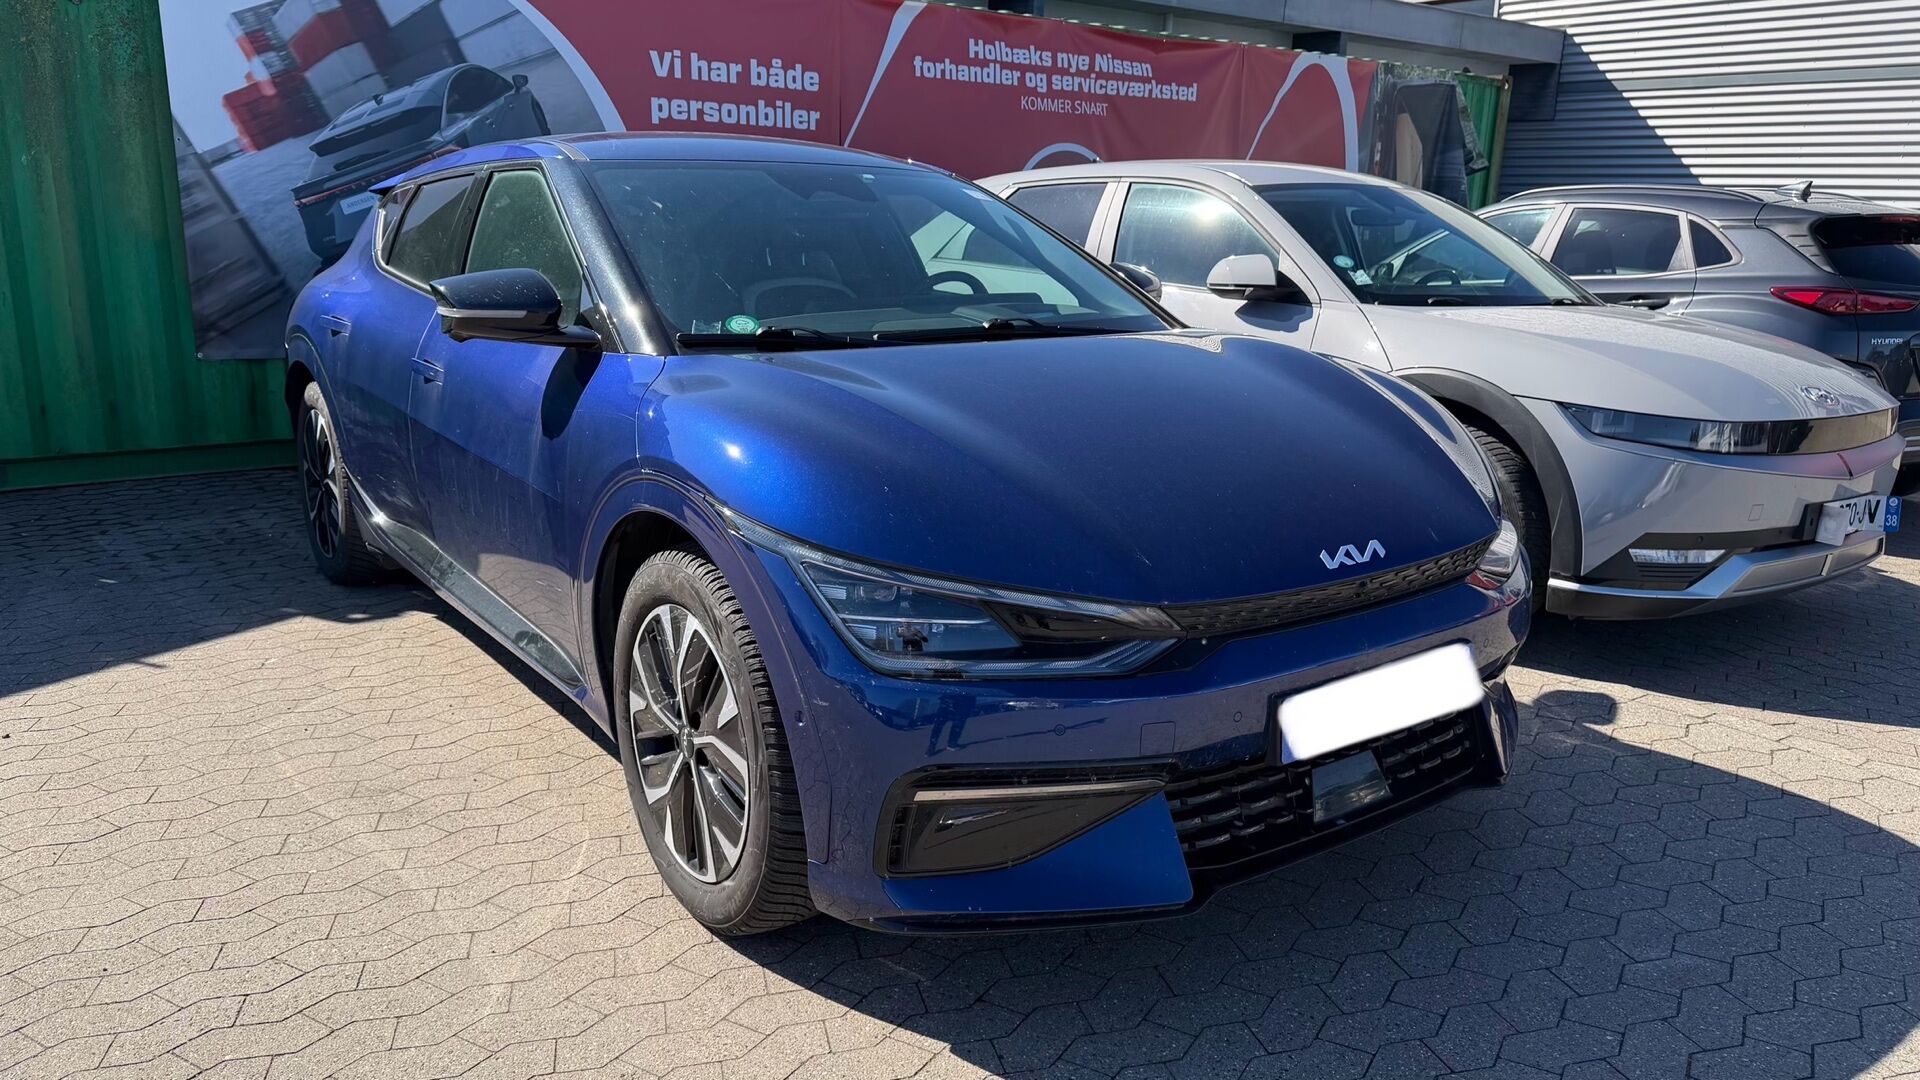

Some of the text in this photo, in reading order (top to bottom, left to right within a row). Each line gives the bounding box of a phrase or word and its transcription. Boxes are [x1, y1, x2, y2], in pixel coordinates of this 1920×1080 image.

[649, 49, 820, 92] Vi har både
[968, 38, 1153, 77] Holbæks nye Nissan
[913, 55, 1198, 102] forhandler og serviceværksted
[650, 96, 820, 131] personbiler
[1021, 95, 1108, 116] KOMMER SNART
[1886, 515, 1897, 526] 38
[1320, 539, 1386, 570] KIA
